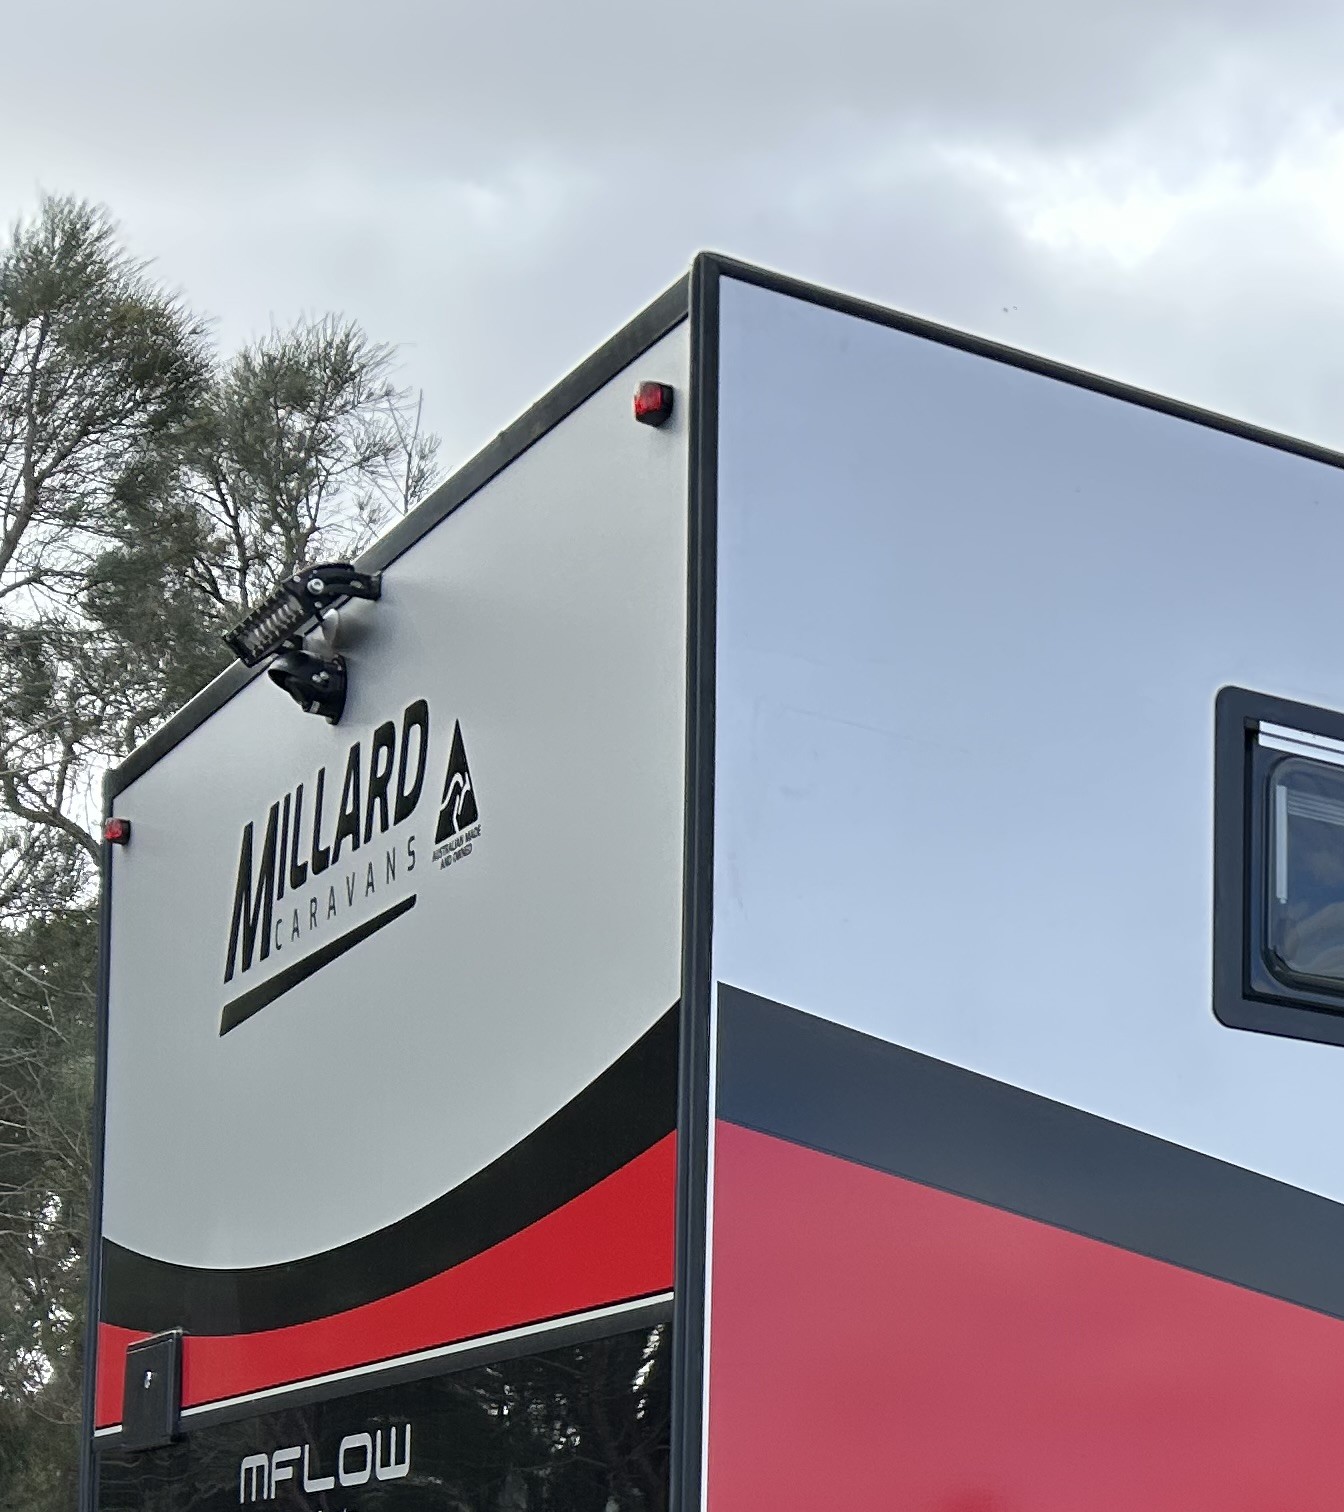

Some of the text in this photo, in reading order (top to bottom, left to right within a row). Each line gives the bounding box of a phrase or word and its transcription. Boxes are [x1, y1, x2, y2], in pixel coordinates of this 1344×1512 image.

[224, 699, 429, 984] MILLARD
[275, 835, 416, 950] CARAVANS
[240, 1423, 412, 1504] MFLOW
